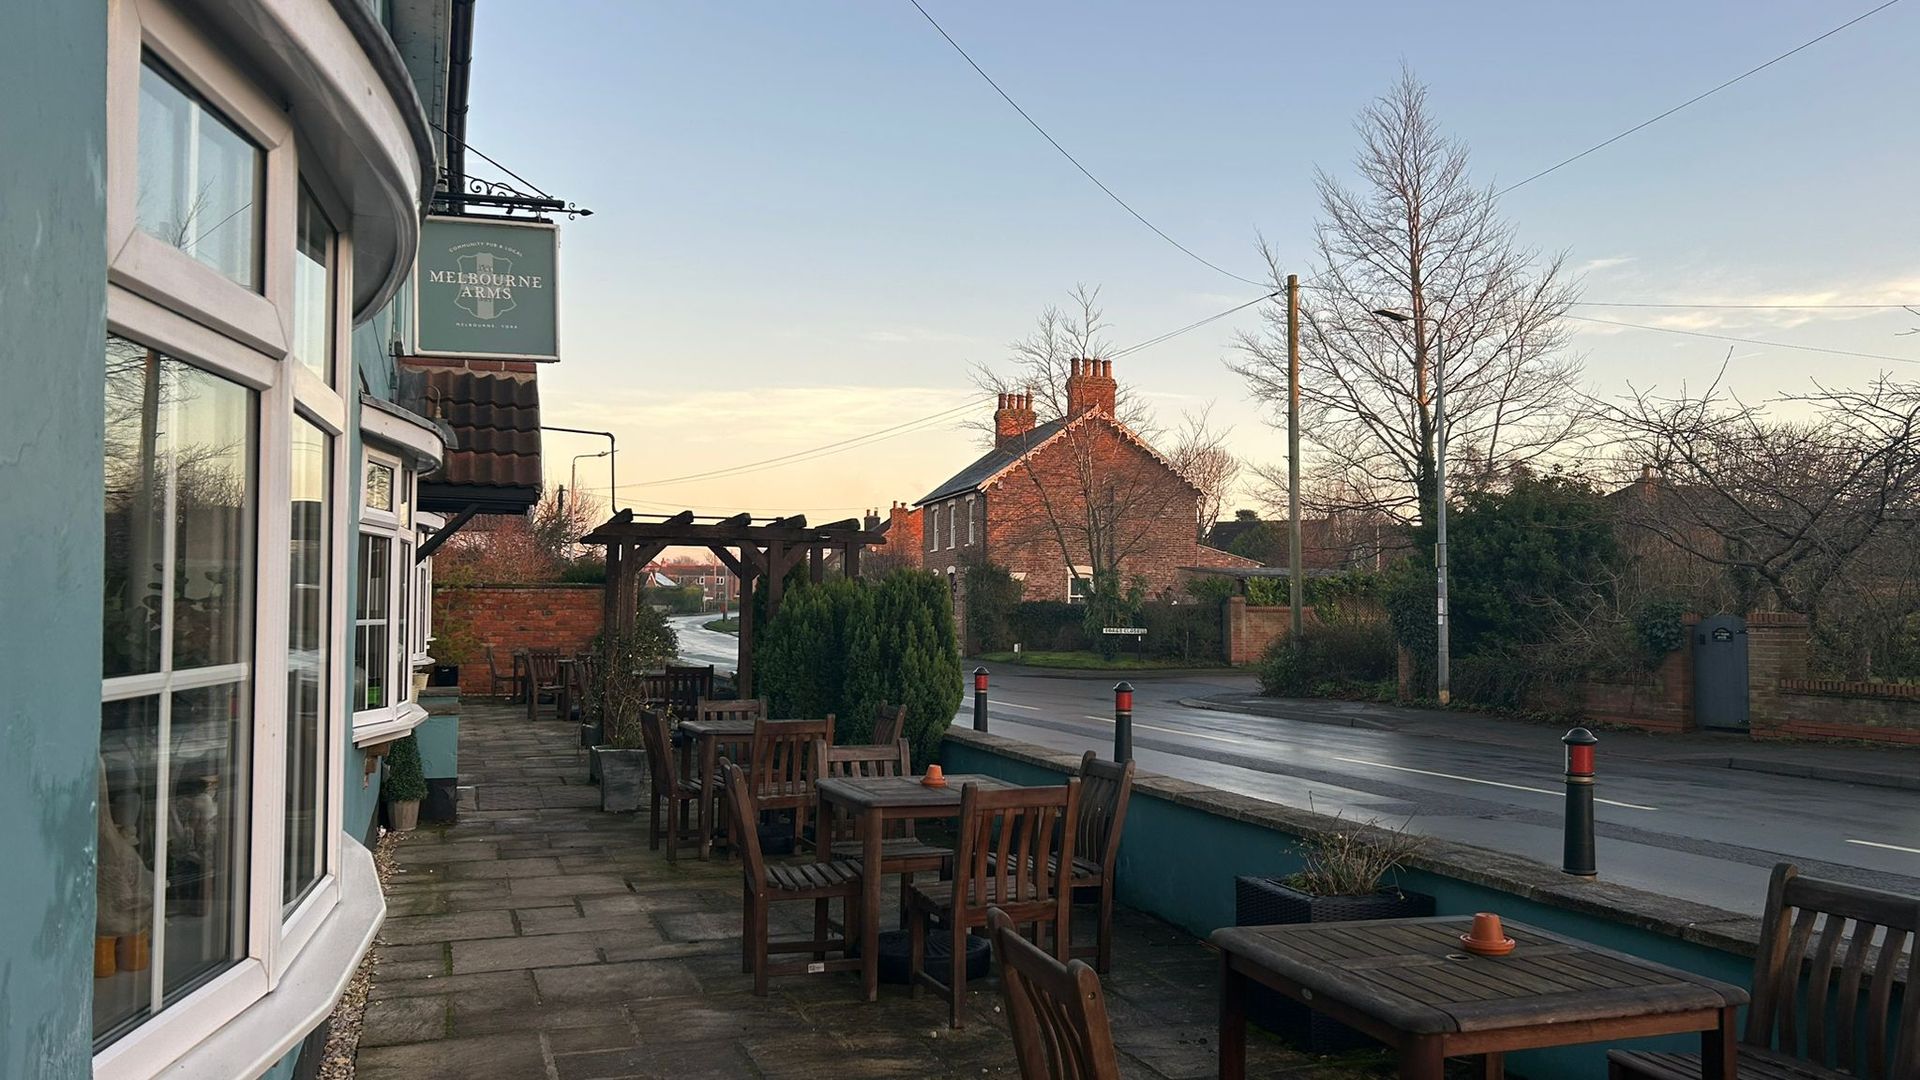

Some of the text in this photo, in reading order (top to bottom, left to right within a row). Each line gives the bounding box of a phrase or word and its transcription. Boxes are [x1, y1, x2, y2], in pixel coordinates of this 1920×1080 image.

[449, 242, 484, 253] COMMUNITY
[504, 246, 523, 257] LOCAL
[429, 270, 542, 288] MELBOURNE
[461, 286, 511, 299] ARMS
